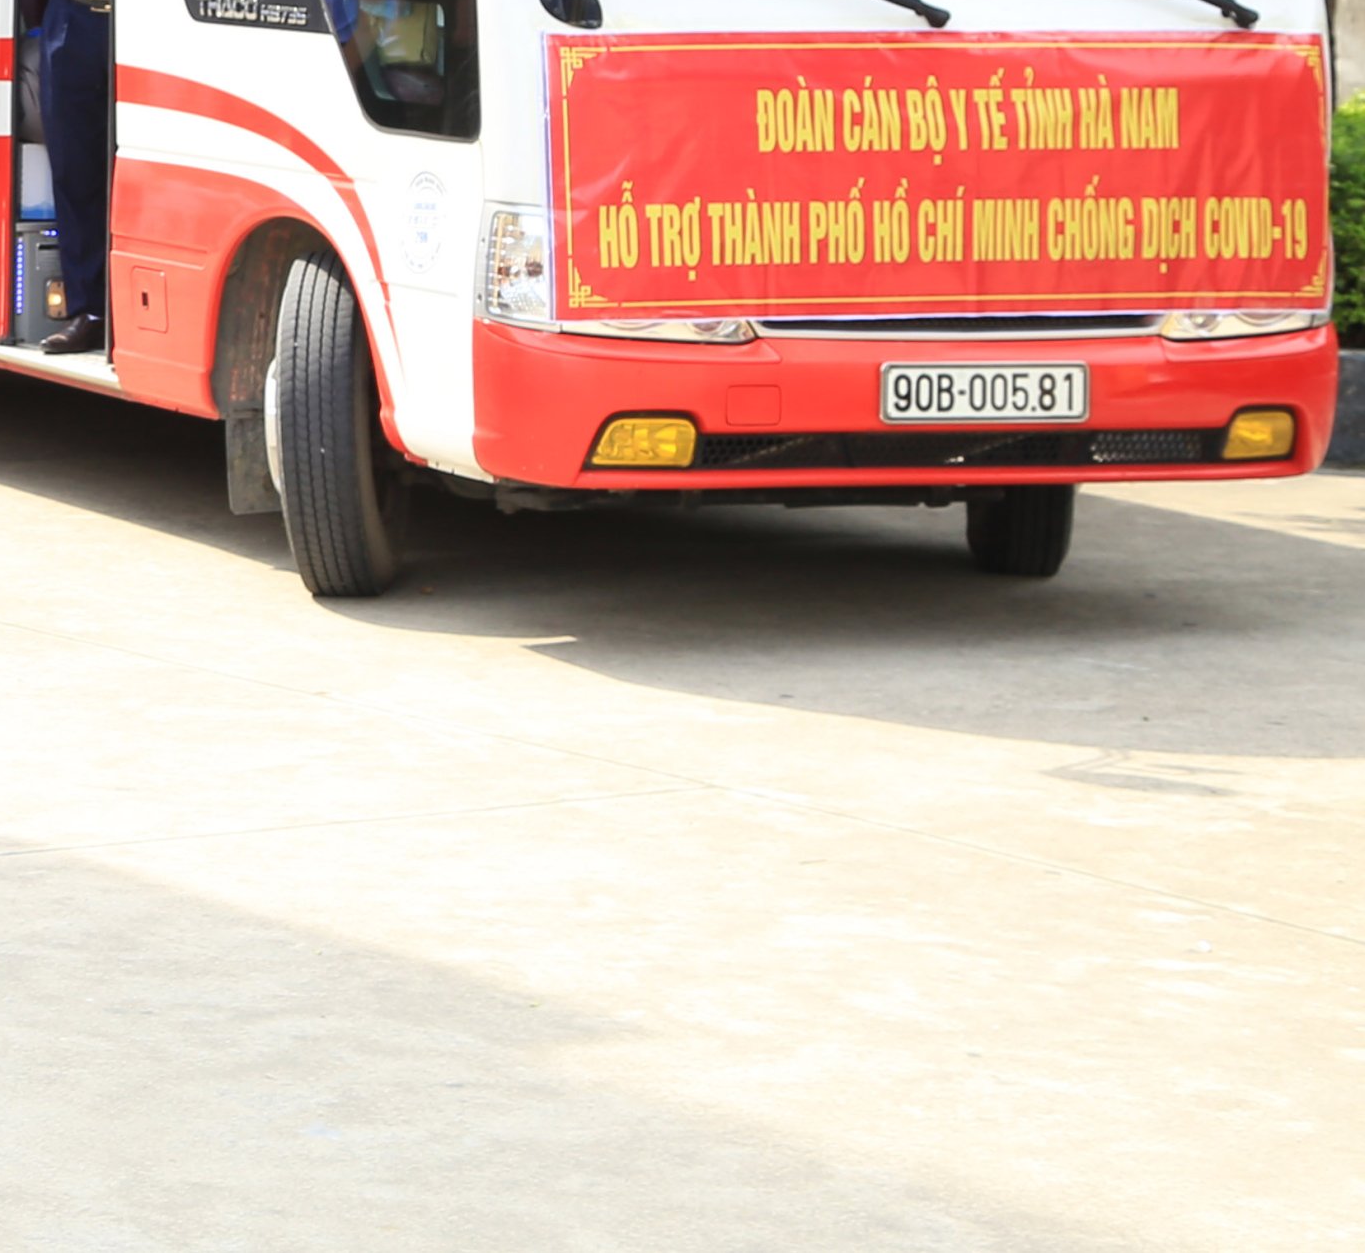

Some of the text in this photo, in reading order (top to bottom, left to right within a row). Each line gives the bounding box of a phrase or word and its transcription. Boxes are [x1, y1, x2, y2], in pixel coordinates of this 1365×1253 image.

[756, 66, 1180, 165] ĐOÀN CÁN BỘ Y TẾ TỈNH HÀ NAM
[599, 174, 1307, 282] HỖ TRỢ THÀNH PHỐ HỒ CHÍ MINH CHỐNG DỊCH COVID-19
[893, 373, 1074, 412] 90B-005.81
